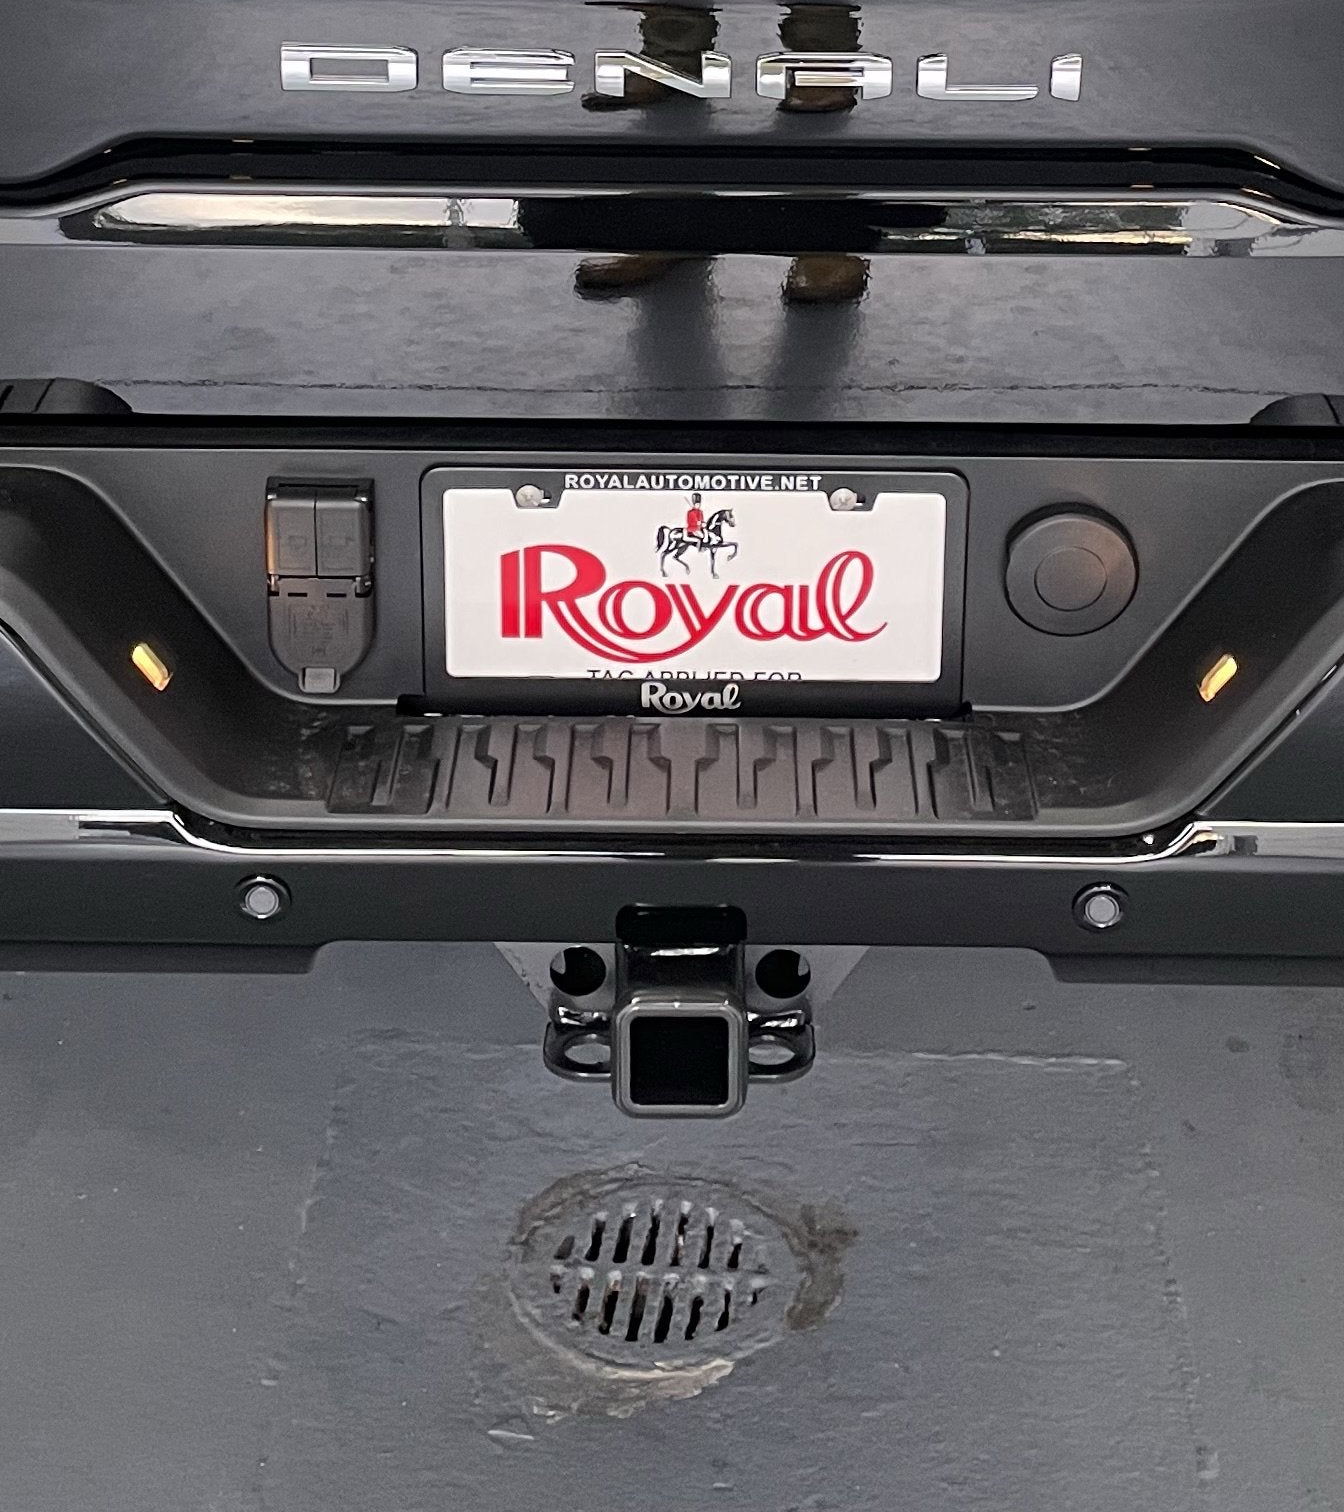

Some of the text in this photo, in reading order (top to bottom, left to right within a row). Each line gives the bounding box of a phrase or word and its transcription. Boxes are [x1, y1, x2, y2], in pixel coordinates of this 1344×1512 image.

[279, 41, 1083, 102] DENALI
[564, 474, 822, 491] ROYALAUTOMOTIVE.NET
[499, 543, 888, 664] Royal
[640, 680, 742, 715] Royal
